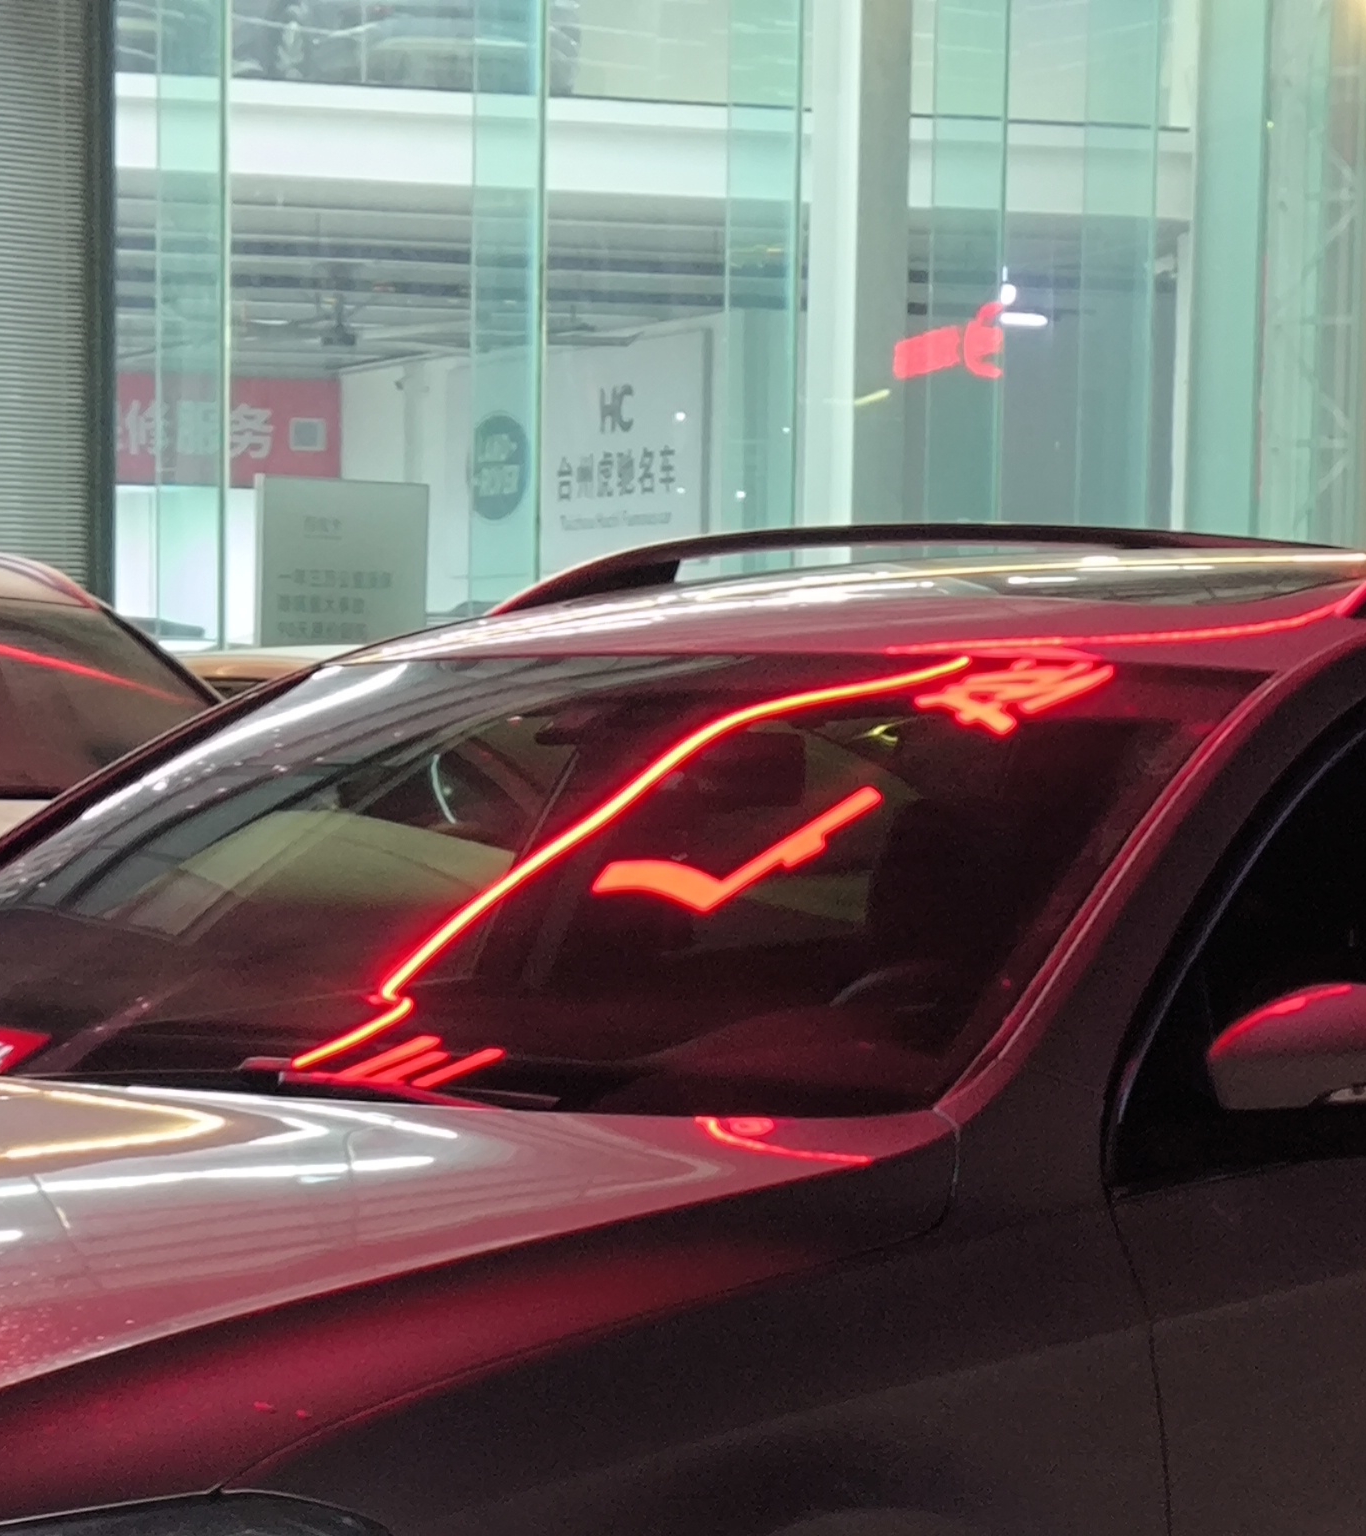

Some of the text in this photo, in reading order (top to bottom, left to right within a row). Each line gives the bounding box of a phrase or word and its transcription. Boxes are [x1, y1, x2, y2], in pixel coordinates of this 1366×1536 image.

[115, 400, 274, 459] 修服务
[598, 384, 635, 434] HC
